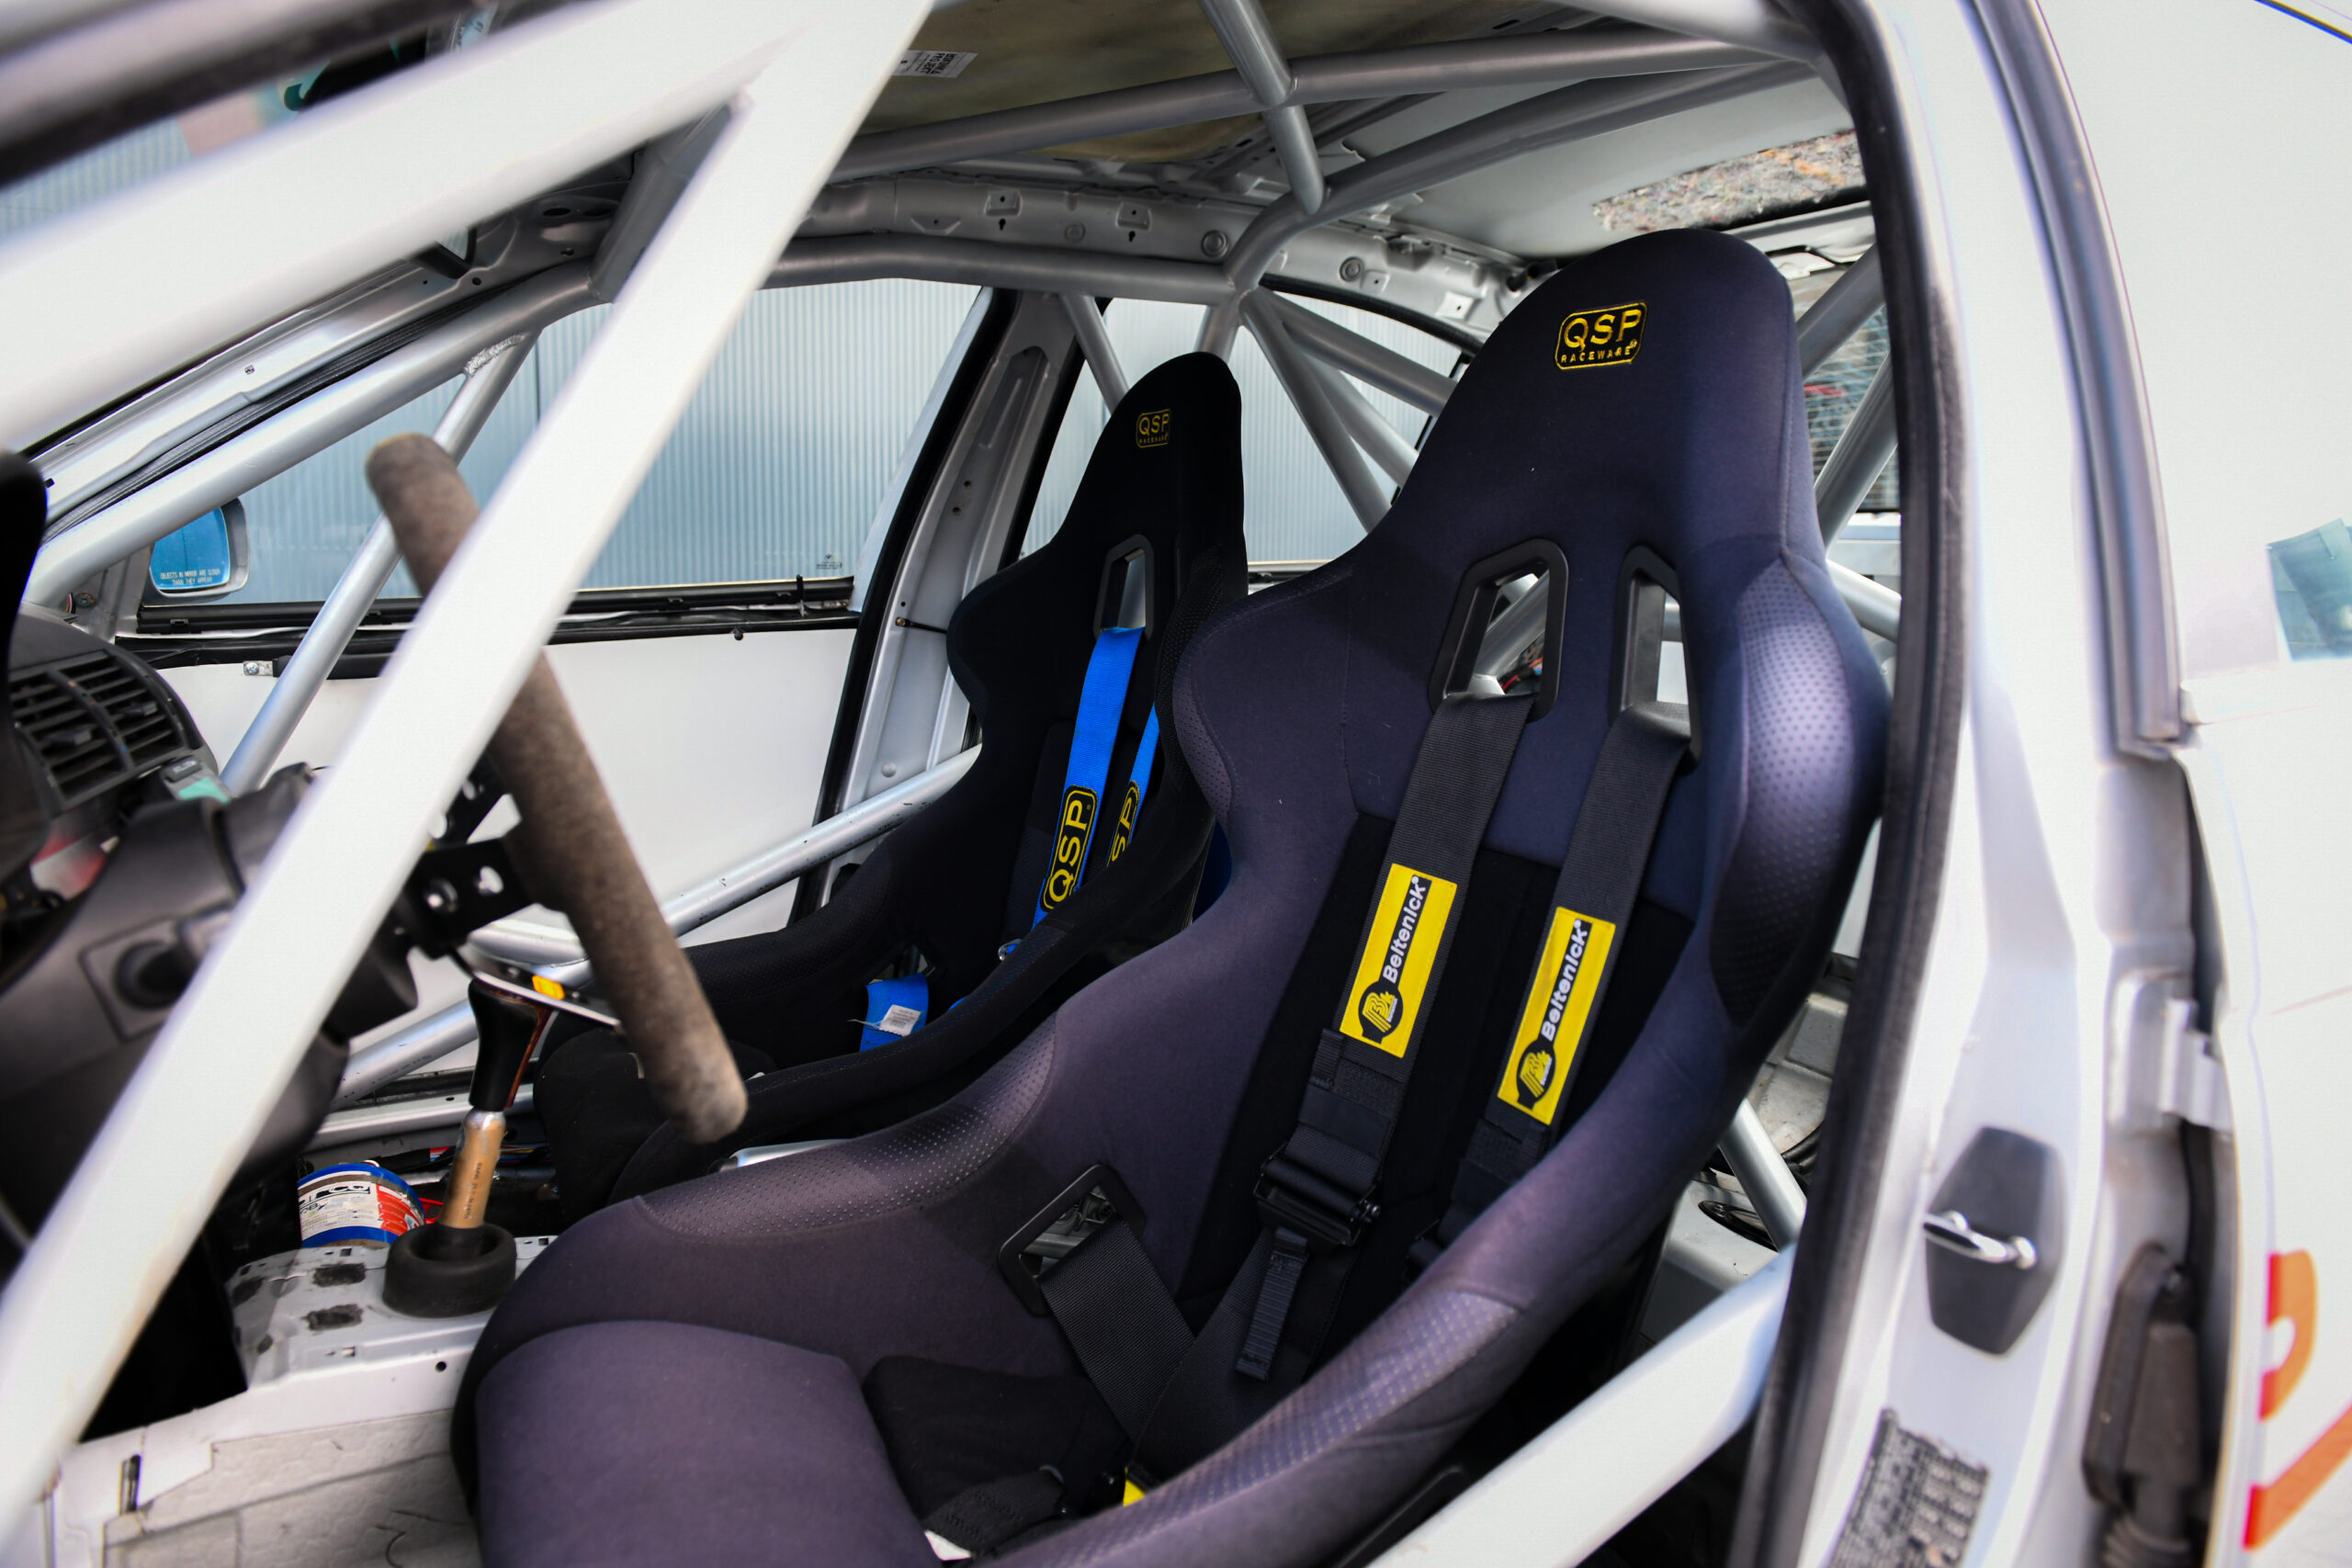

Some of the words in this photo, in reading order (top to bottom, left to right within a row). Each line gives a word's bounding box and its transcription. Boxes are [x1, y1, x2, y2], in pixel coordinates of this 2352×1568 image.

[1561, 346, 1631, 363] RACEWARE
[1564, 310, 1642, 350] QSP
[1139, 413, 1169, 436] QSP
[1048, 800, 1087, 902] QSP
[1111, 797, 1132, 862] SP
[1382, 879, 1426, 984] Beltenick
[1541, 926, 1588, 1042] Beltenick
